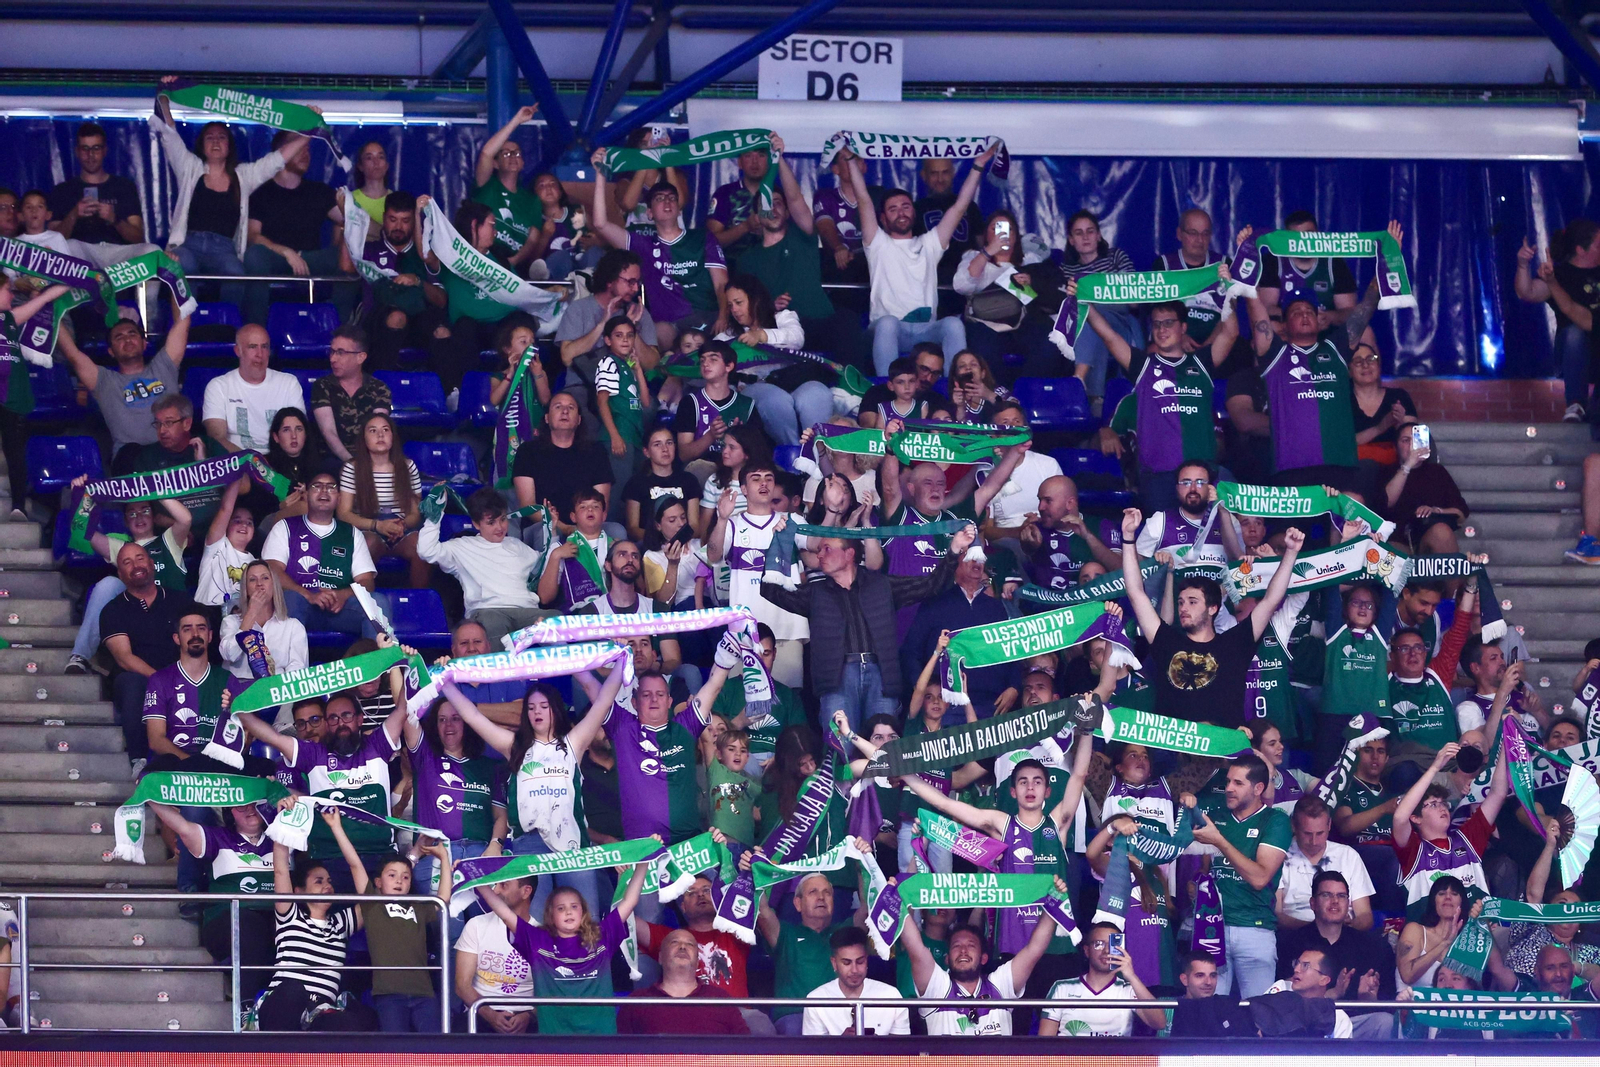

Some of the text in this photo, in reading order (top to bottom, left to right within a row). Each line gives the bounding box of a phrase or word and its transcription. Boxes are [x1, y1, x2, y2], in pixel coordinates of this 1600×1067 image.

[770, 39, 893, 65] SECTOR
[807, 70, 859, 101] D6
[217, 88, 273, 110] UNICAJA
[203, 96, 283, 126] BALONCESTO
[1288, 239, 1372, 253] BALONCESTO
[1106, 273, 1165, 286] UNICAJA
[1094, 284, 1179, 300] BALONCESTO
[1310, 371, 1336, 381] Unicaja
[1174, 386, 1202, 396] Unicaja
[86, 455, 240, 498] UNICAJA BALONCESTO
[1238, 484, 1299, 497] UNICAJA
[1227, 493, 1311, 513] BALONCESTO
[1199, 554, 1226, 563] Unicaja
[1316, 562, 1346, 575] Unicaja
[317, 564, 343, 577] Unicaja
[982, 610, 1074, 644] BALONCESTO
[541, 642, 610, 662] VERDE
[1000, 629, 1063, 657] UNICAJA
[280, 659, 346, 684] UNICAJA
[269, 666, 364, 703] BALONCESTO
[1255, 696, 1267, 718] 9
[1136, 710, 1198, 734] UNICAJA
[921, 731, 975, 762] UNICAJA
[977, 708, 1048, 749] BALONCESTO
[1047, 710, 1066, 722] MALAGA
[1119, 722, 1210, 752] BALONCESTO
[160, 785, 244, 802] BALONCESTO
[461, 782, 491, 793] Unicaja
[930, 824, 956, 843] FINAL
[956, 840, 982, 857] FOUR
[528, 850, 621, 873] BALONCESTO
[933, 873, 998, 888] UNICAJA
[919, 888, 1014, 904] BALONCESTO
[479, 953, 505, 973] 53
